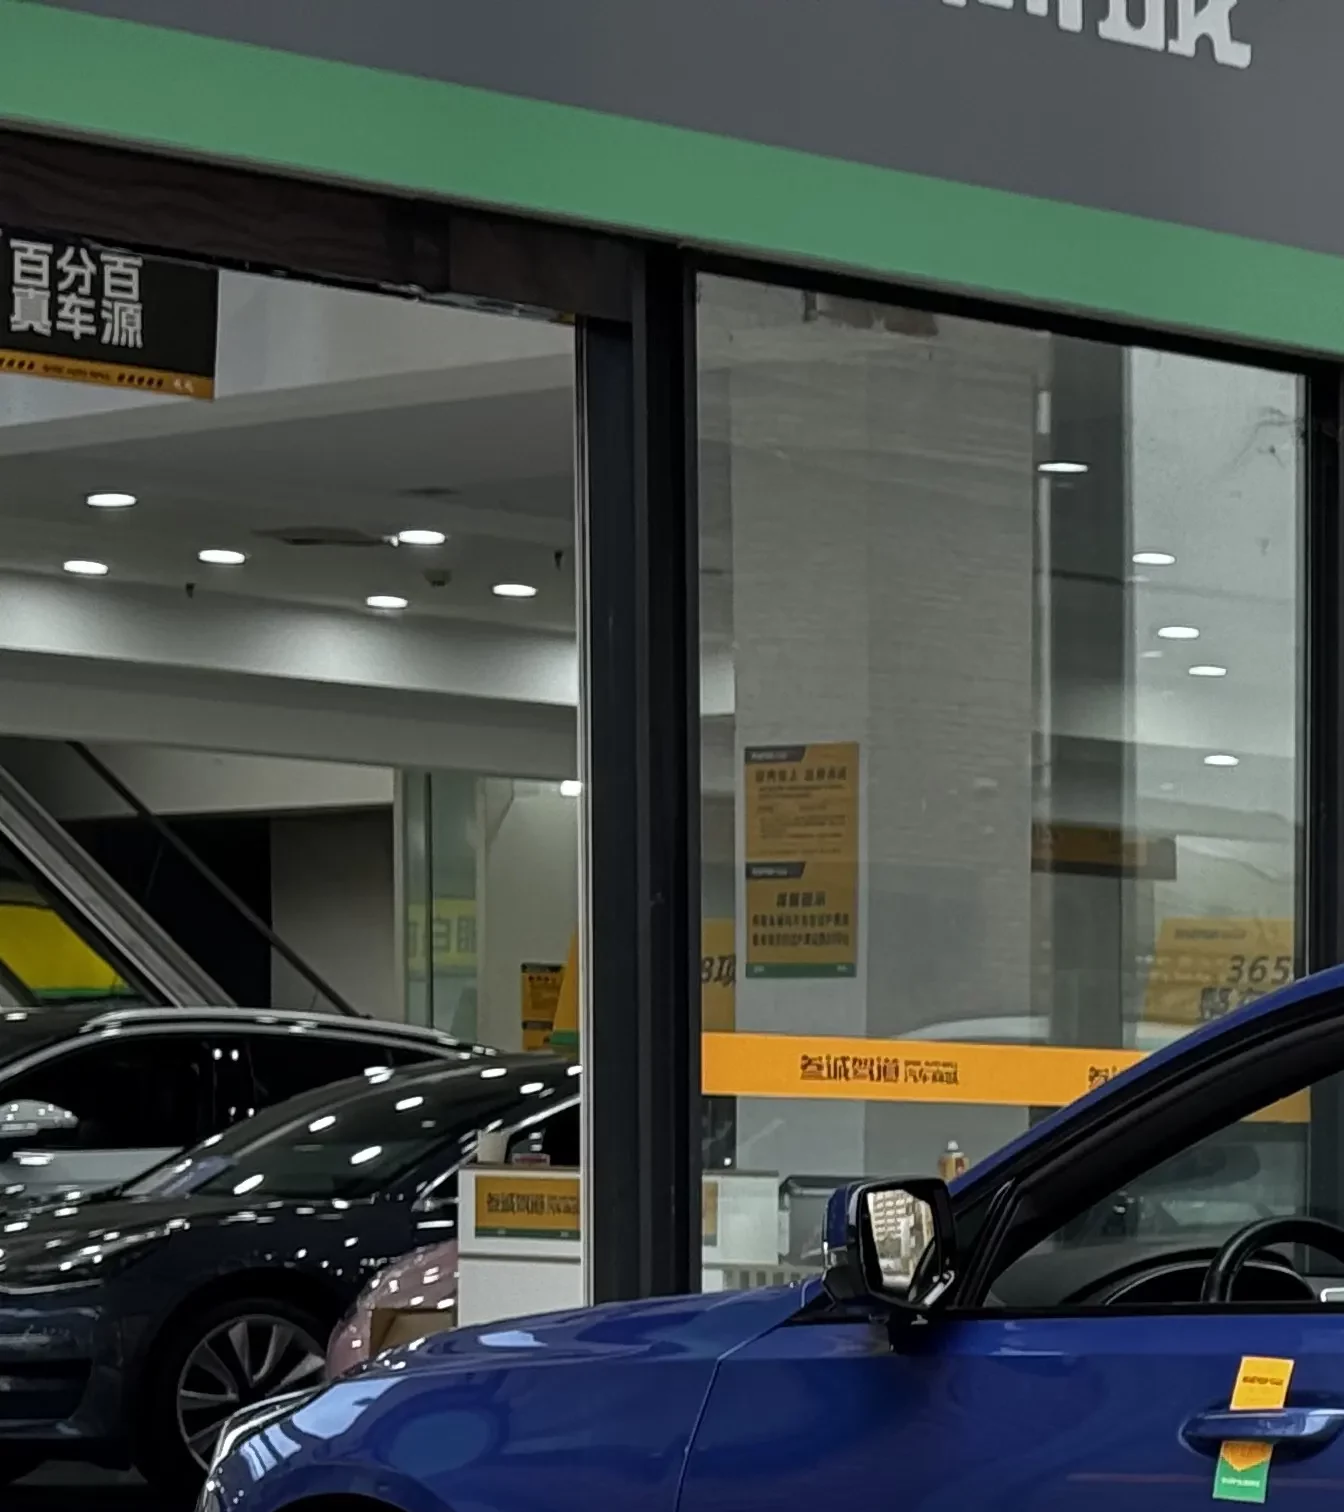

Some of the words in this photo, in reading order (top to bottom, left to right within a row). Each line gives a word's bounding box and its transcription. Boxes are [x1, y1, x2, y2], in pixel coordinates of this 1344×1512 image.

[9, 238, 143, 302] 百分百
[9, 286, 144, 349] 真车源
